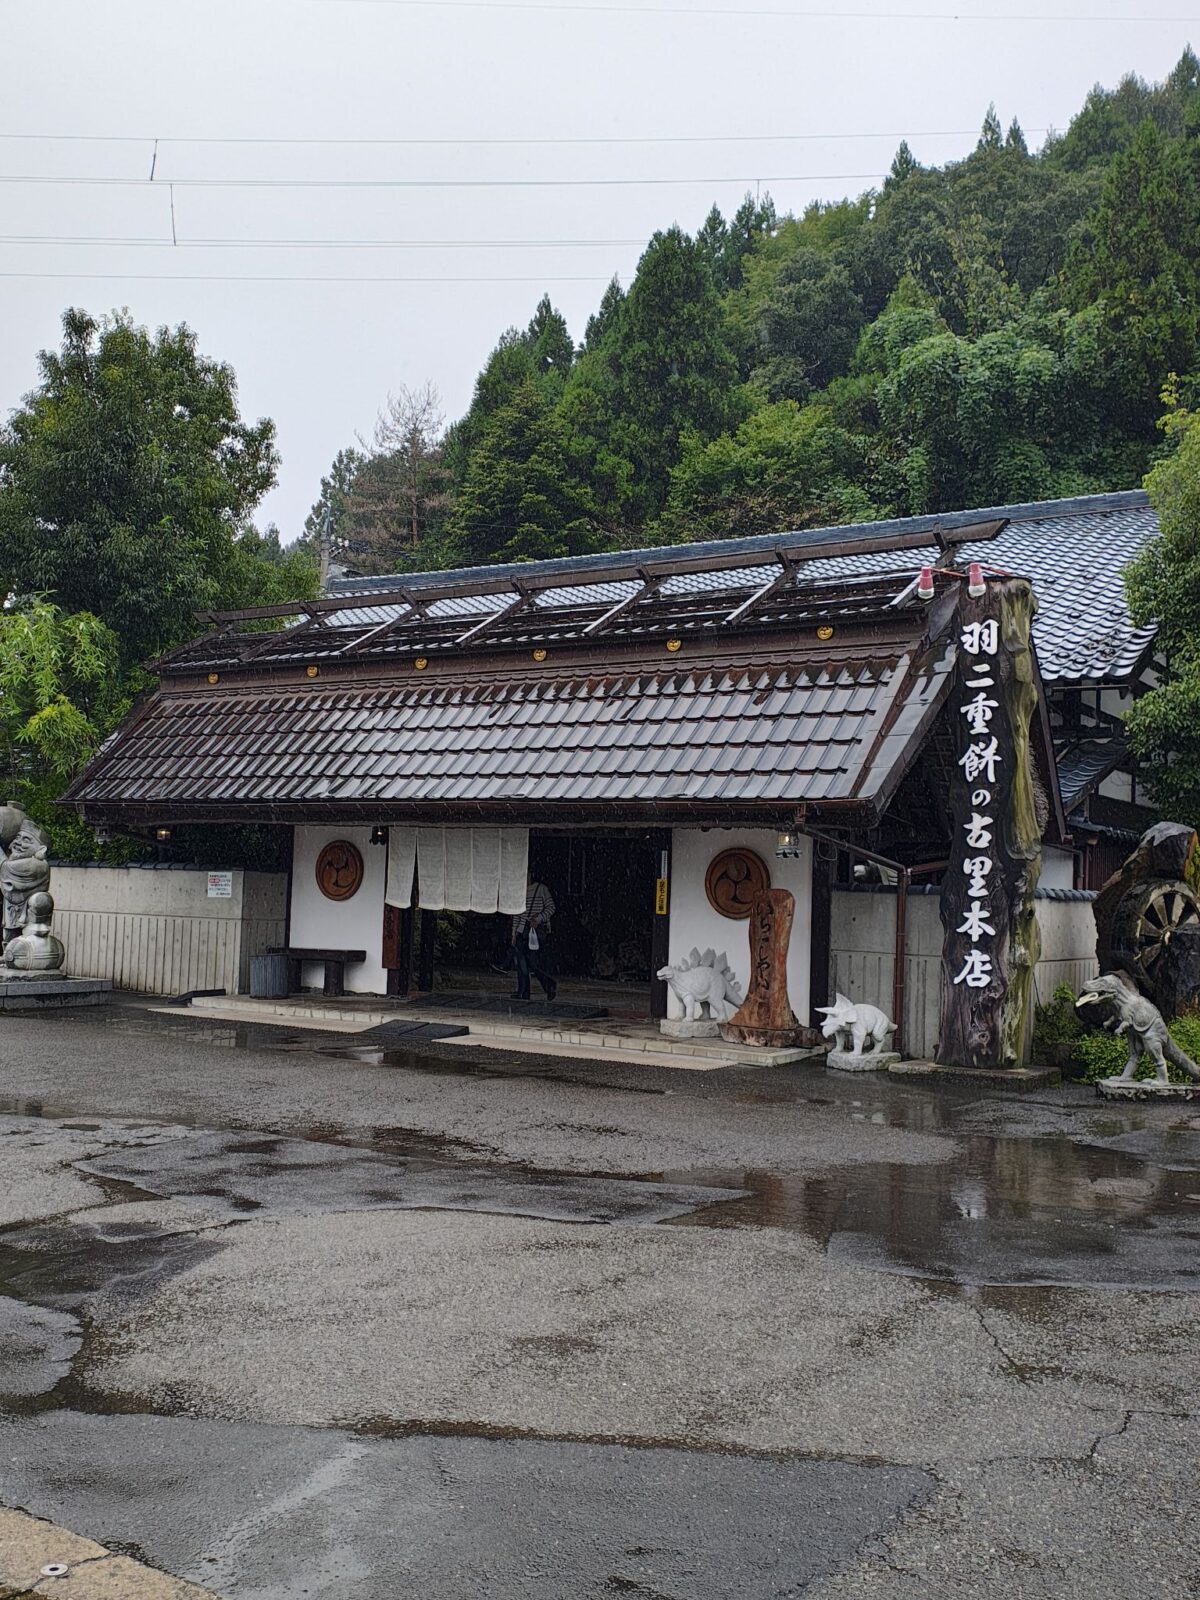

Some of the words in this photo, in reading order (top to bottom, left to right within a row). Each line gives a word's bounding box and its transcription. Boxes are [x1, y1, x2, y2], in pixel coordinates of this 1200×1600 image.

[954, 619, 1002, 988] 羽二重餅の古里本店
